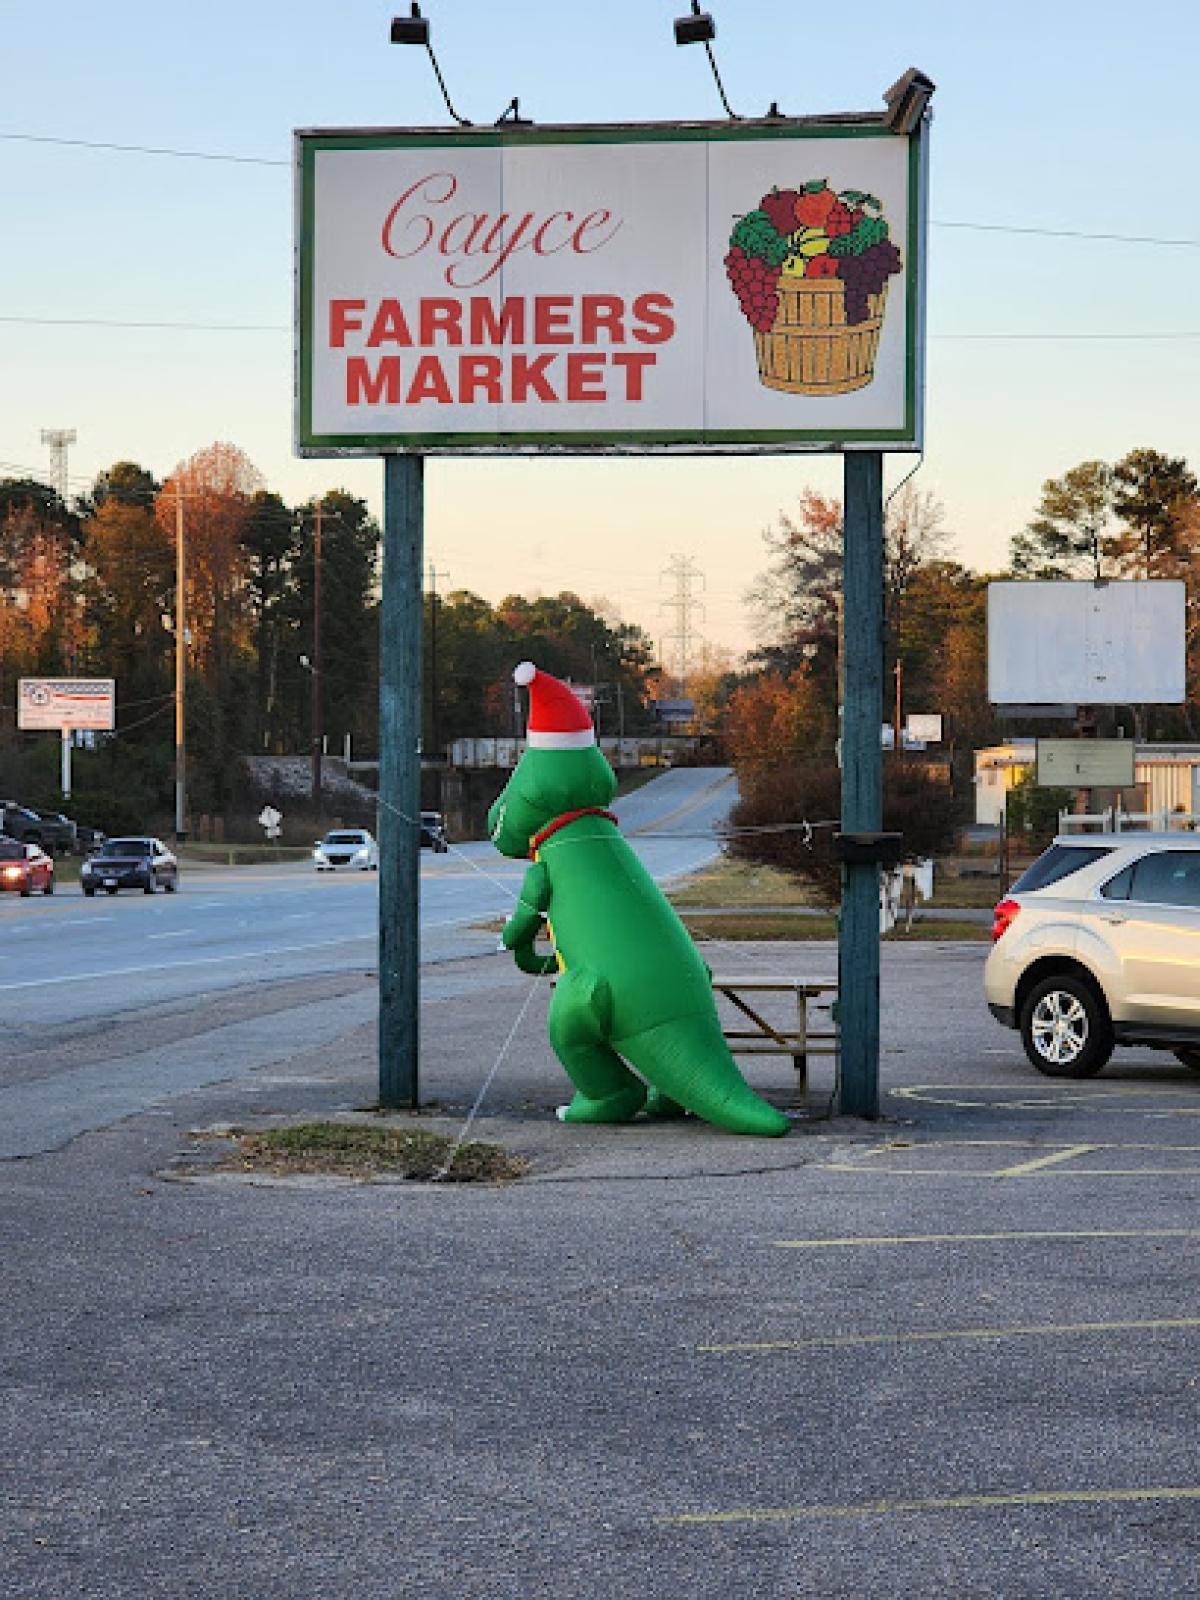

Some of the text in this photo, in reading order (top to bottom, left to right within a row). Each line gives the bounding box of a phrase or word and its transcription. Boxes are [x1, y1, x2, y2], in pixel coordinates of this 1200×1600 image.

[381, 172, 623, 288] Cayce
[329, 292, 676, 348] FARMERS
[346, 353, 656, 405] MARKET
